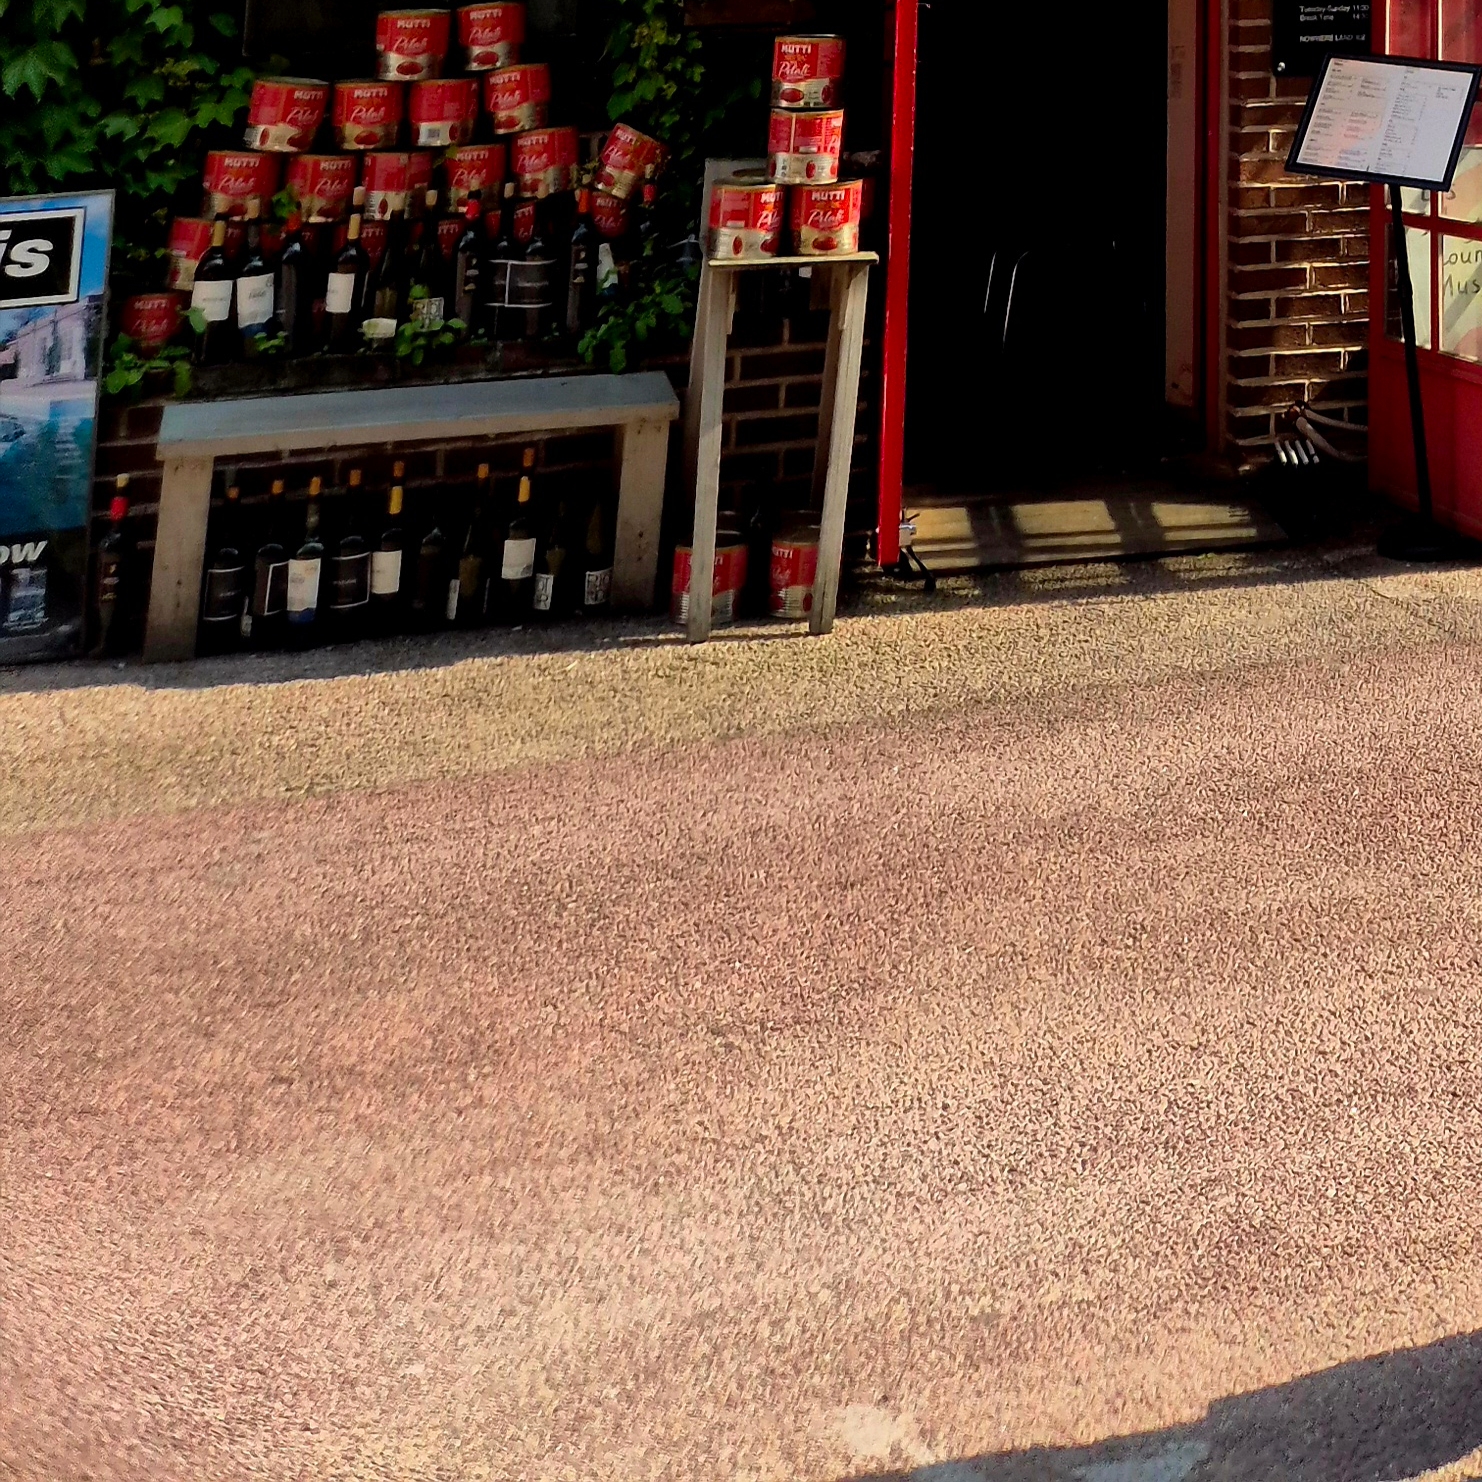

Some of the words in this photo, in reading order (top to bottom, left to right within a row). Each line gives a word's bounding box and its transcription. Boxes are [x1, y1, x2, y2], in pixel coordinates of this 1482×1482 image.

[470, 8, 502, 20] MUTTI
[397, 19, 430, 29] MUTTI
[781, 43, 812, 54] MUTTI
[779, 60, 812, 78] Pelati
[489, 72, 521, 85] MUTTI
[354, 88, 388, 99] MUTTI
[518, 134, 549, 147] MUTTI
[456, 151, 489, 162] MUTTI
[224, 157, 260, 168] MUTTI
[811, 190, 845, 201] MUTTI
